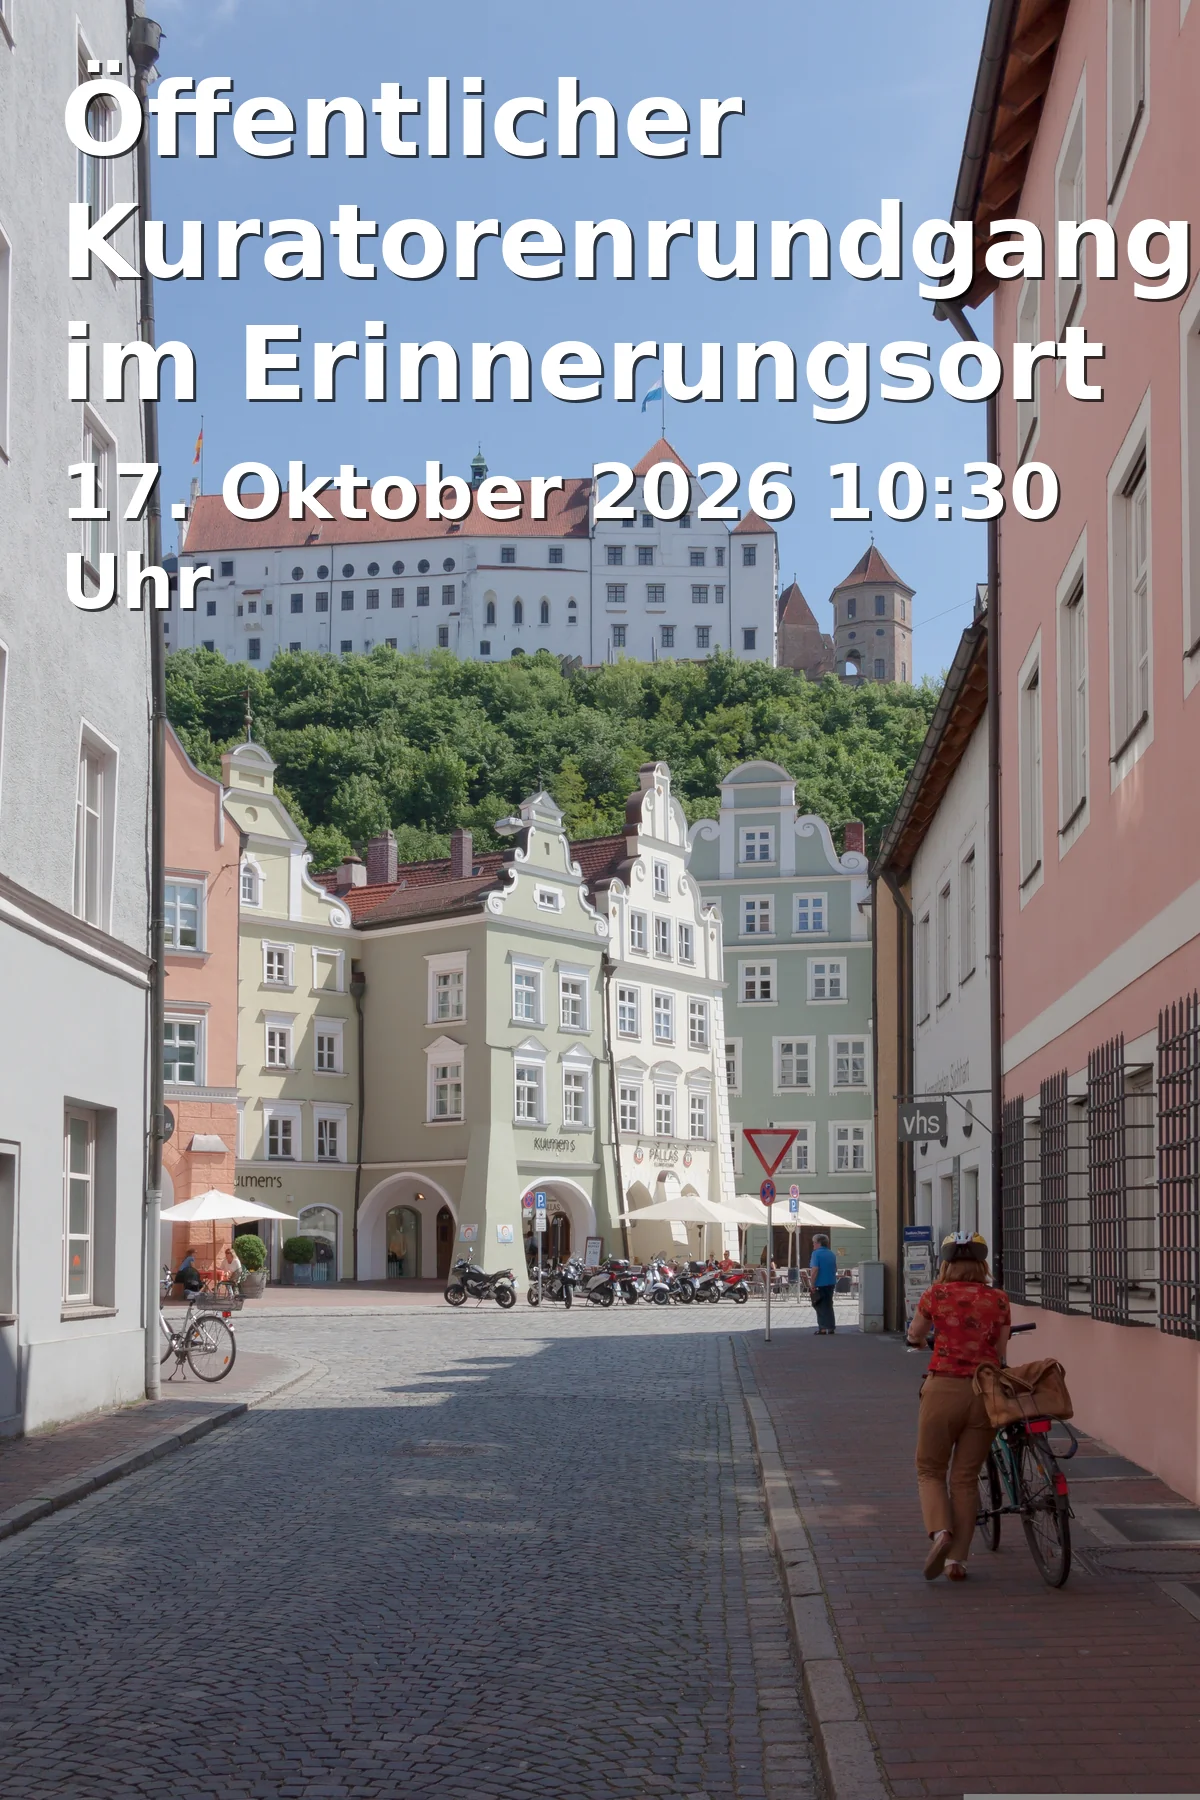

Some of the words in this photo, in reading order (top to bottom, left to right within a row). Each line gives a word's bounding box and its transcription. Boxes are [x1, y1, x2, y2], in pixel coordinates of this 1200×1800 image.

[902, 1109, 940, 1135] vhs
[649, 1148, 679, 1163] PALLAS
[234, 1175, 282, 1188] ulmen's
[537, 1195, 543, 1207] P
